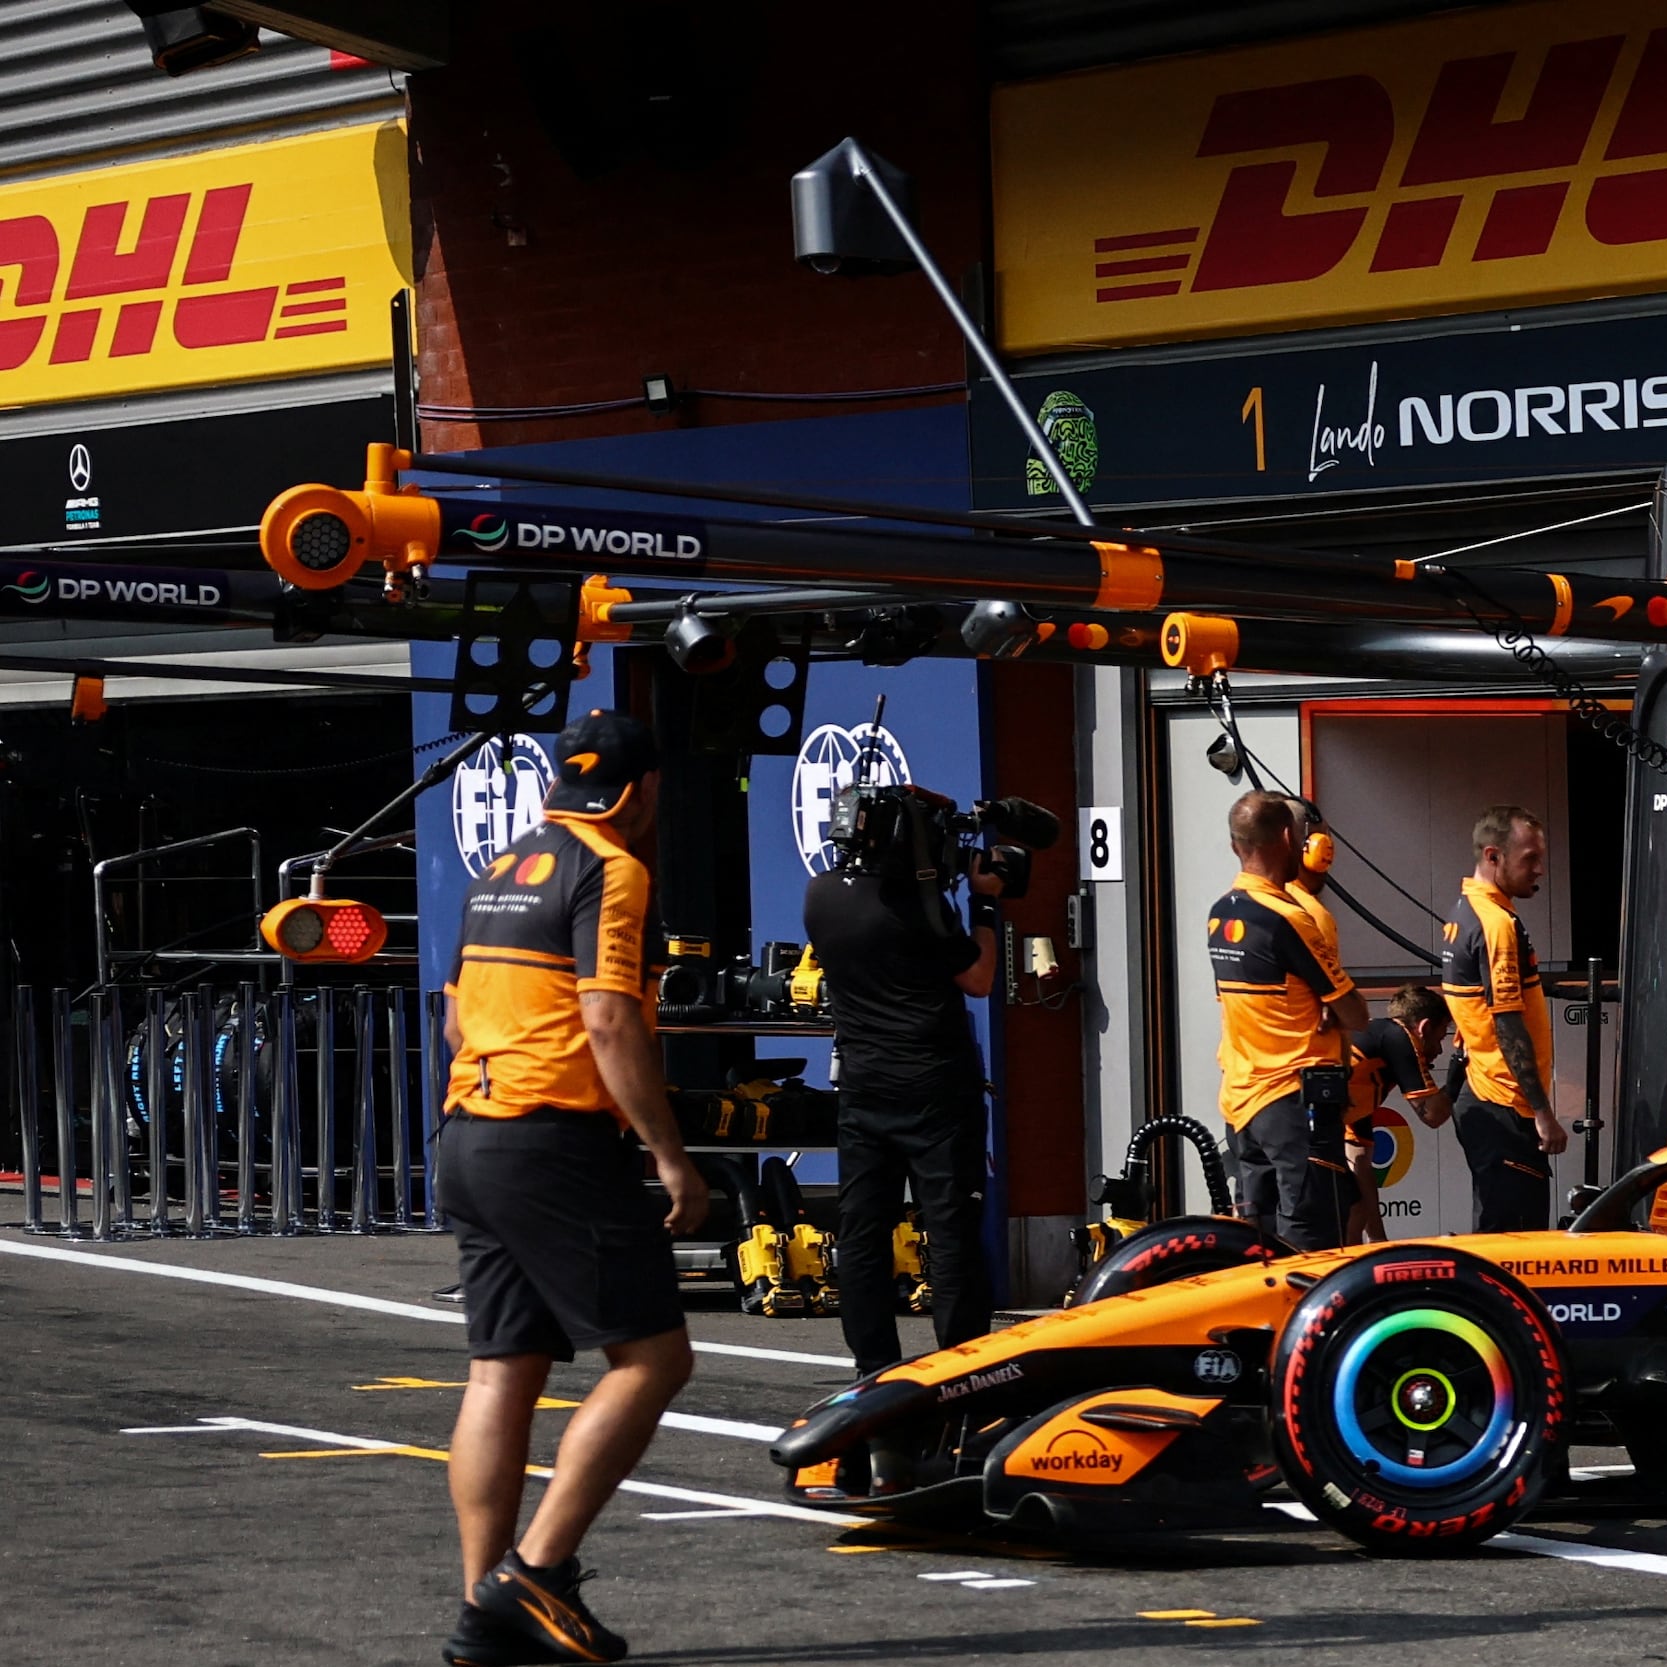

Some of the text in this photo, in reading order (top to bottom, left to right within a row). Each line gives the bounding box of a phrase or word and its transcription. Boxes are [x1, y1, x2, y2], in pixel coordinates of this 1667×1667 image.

[1241, 387, 1266, 472] 1
[1309, 361, 1386, 483] Lando
[66, 509, 99, 521] PETRONAS
[518, 522, 701, 561] DP WORLD
[58, 578, 221, 606] DP WORLD
[1654, 794, 1667, 811] DP
[1091, 819, 1109, 869] 8
[1379, 1200, 1422, 1217] ome
[1373, 1260, 1456, 1284] PIRELLI
[1501, 1258, 1599, 1276] RICHARD
[1548, 1303, 1621, 1322] ORLD
[938, 1363, 1025, 1402] JACK DANIEL'S
[1032, 1451, 1123, 1472] workday
[1371, 1501, 1497, 1538] ZERO
